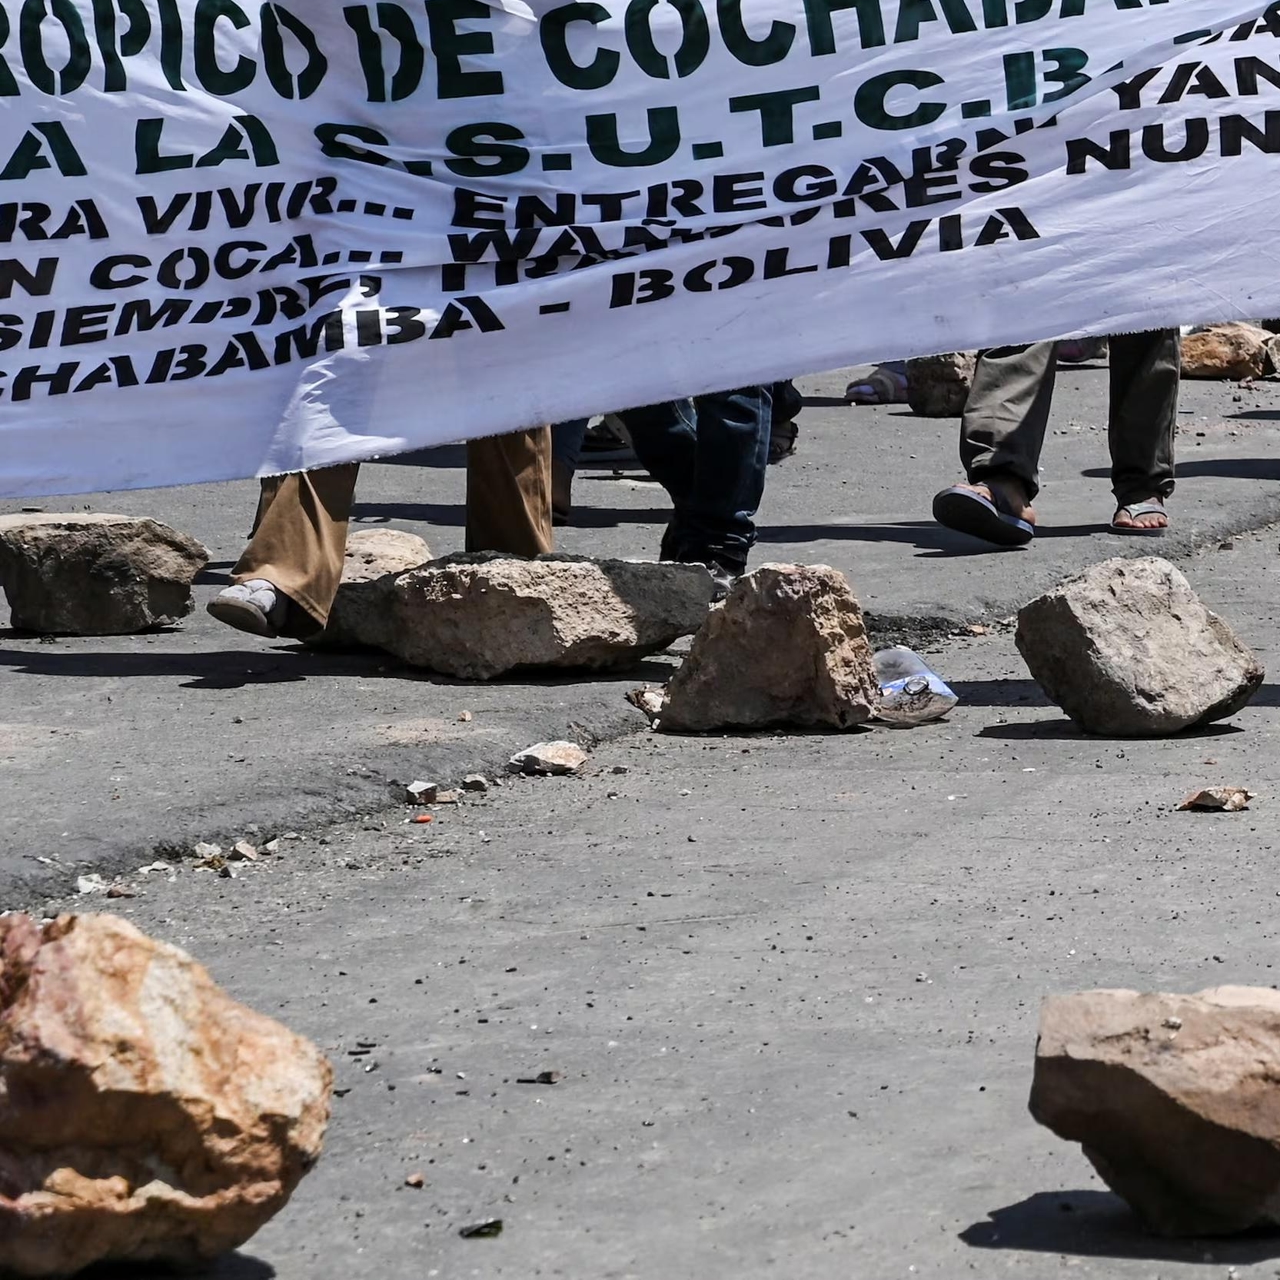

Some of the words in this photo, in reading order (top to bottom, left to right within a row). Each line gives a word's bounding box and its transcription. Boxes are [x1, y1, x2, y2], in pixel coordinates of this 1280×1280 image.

[135, 115, 280, 175] LA
[0, 297, 505, 402] HABAMBA
[609, 207, 1041, 309] BOLIVIA
